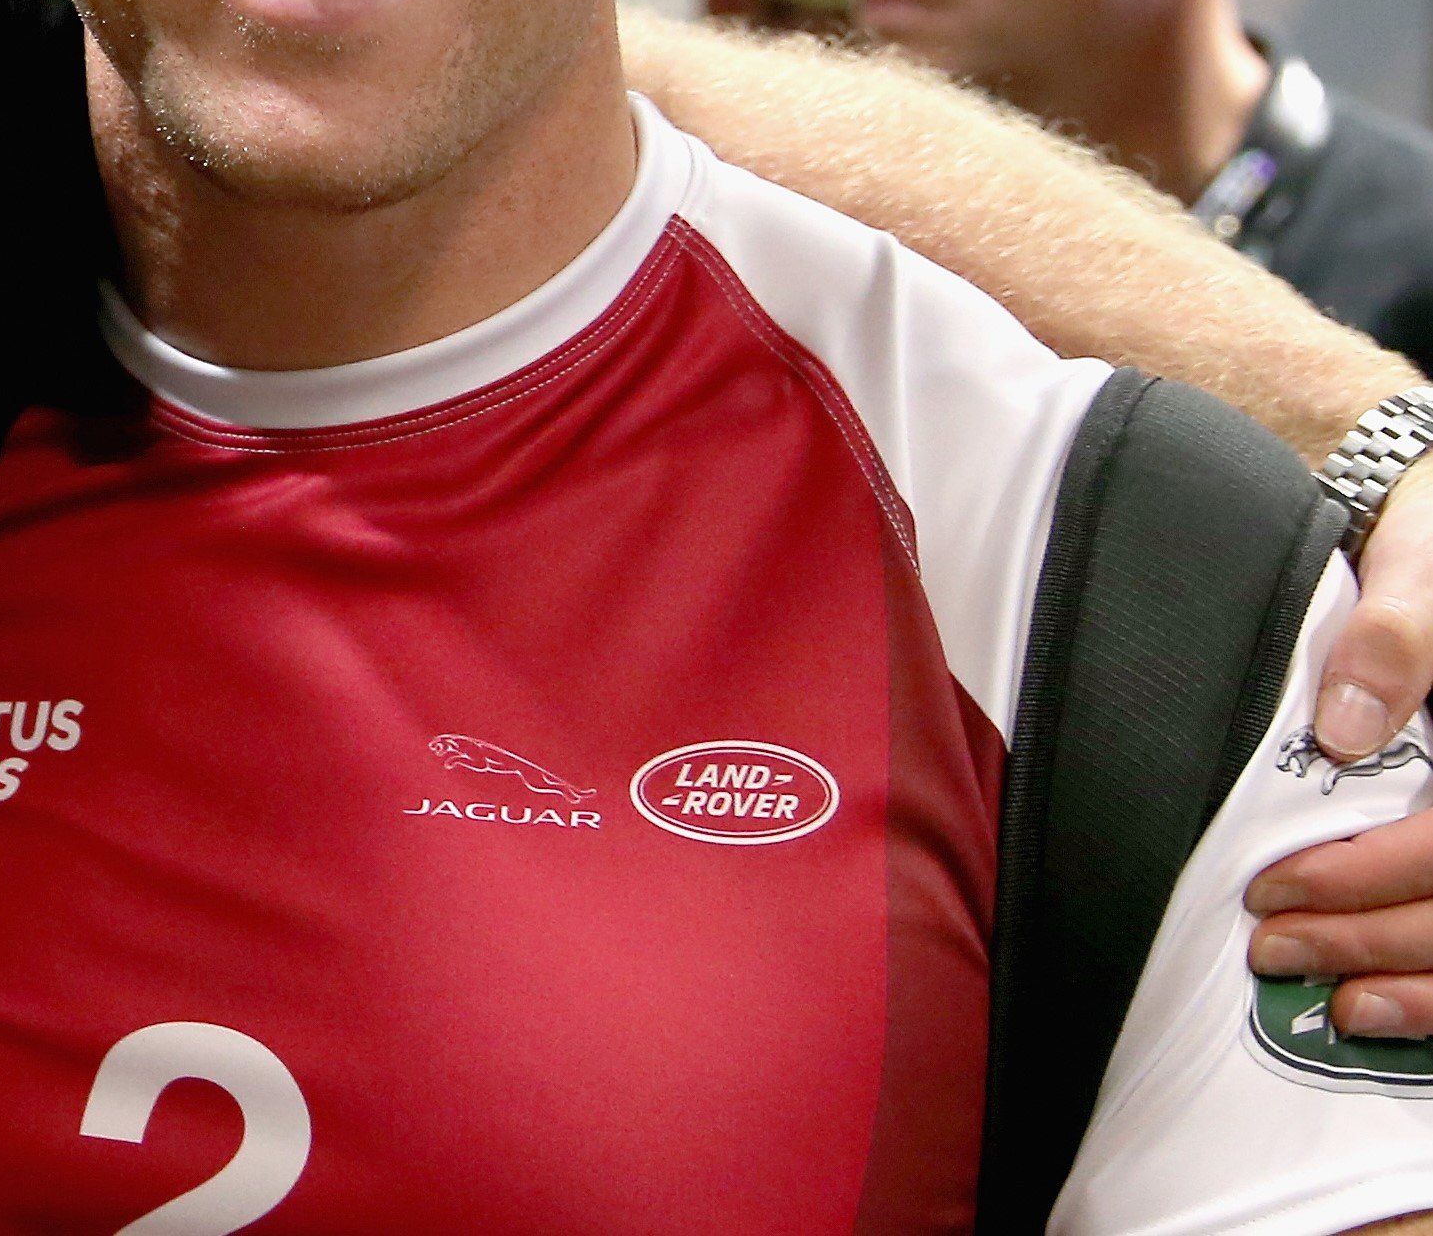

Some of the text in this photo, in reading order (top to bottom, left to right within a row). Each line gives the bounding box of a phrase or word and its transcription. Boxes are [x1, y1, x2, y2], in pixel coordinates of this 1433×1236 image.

[674, 763, 771, 790] LAND
[402, 797, 602, 830] JAGUAR
[681, 791, 800, 820] ROVER
[79, 1020, 312, 1236] 2
